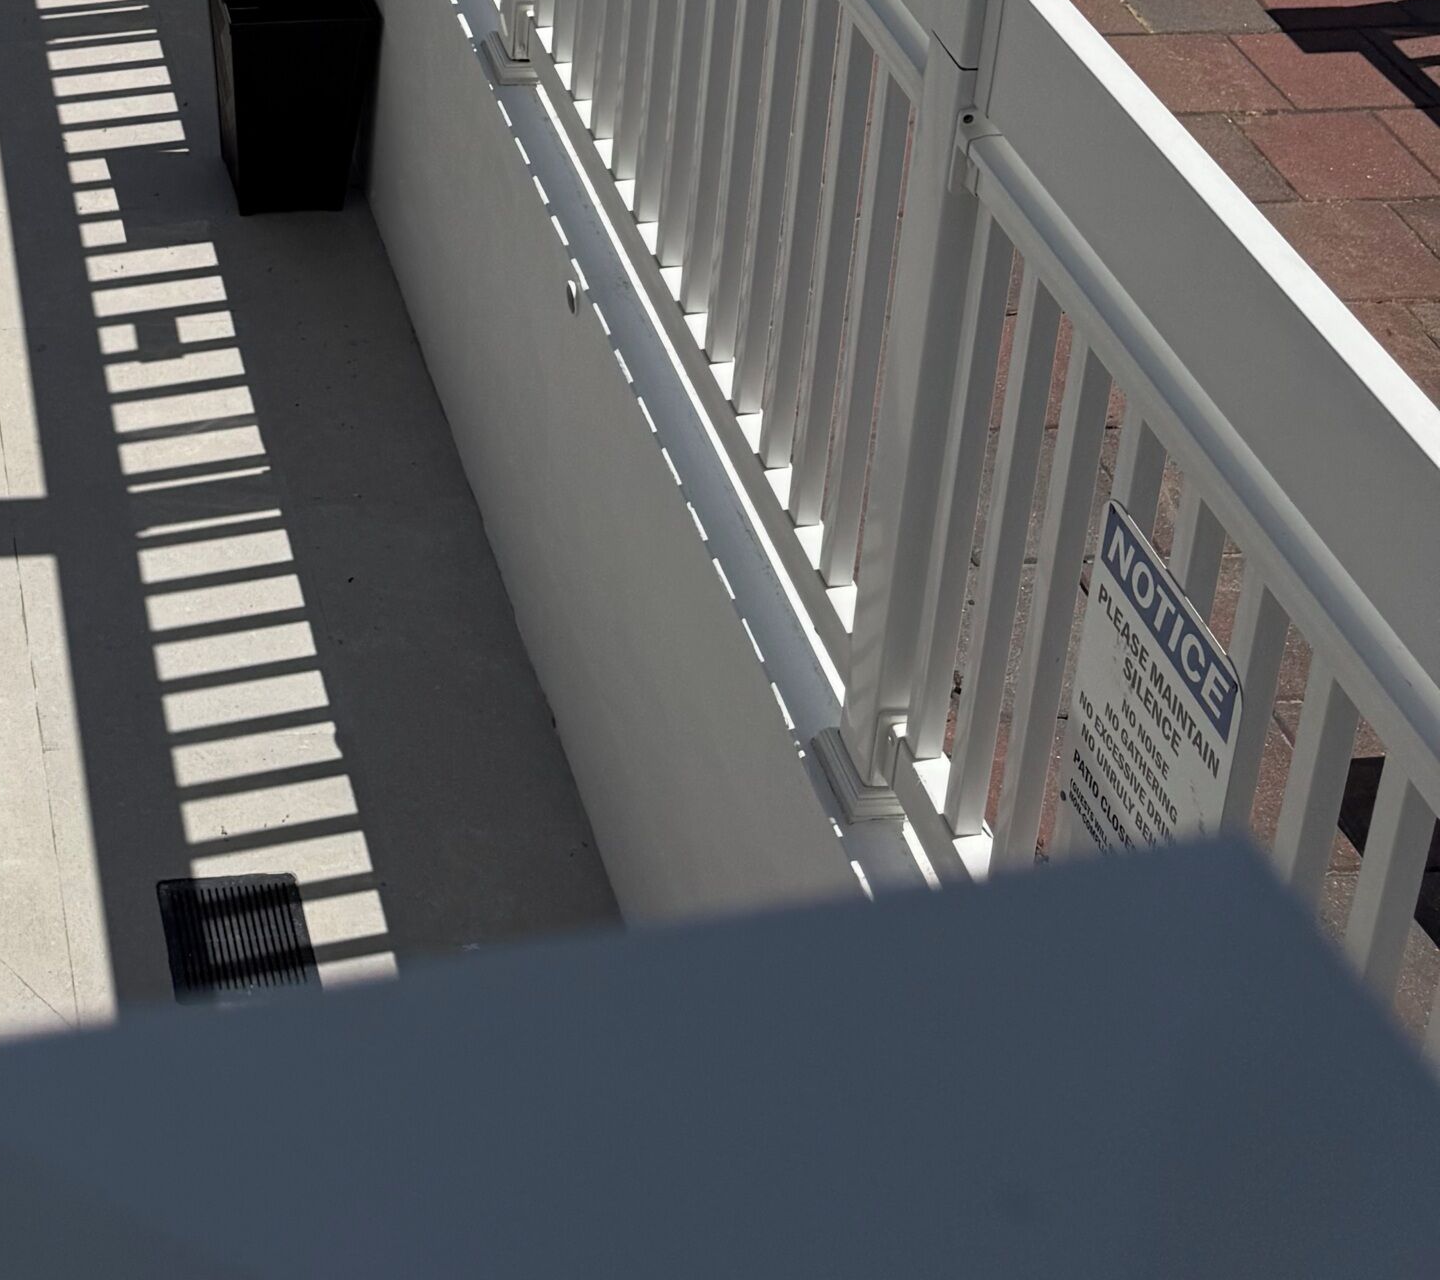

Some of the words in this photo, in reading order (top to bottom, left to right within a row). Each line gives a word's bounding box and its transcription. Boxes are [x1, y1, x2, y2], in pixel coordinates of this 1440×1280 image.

[1106, 524, 1231, 720] NOTICE
[1098, 583, 1150, 671] PLEASE
[1149, 660, 1221, 779] MAINTAIN
[1122, 657, 1182, 757] SILENCE
[1078, 690, 1093, 720] NO
[1094, 714, 1147, 806] EXCESSIVE
[1146, 798, 1174, 843] DRIN
[1080, 723, 1095, 752] NO
[1096, 747, 1136, 815] UNRULY
[1104, 701, 1120, 731] NO
[1120, 728, 1178, 826] GATHERING
[1121, 698, 1137, 728] NO
[1137, 723, 1170, 781] NOISE
[1072, 748, 1099, 799] PATIO
[1100, 795, 1136, 849] CLOSE
